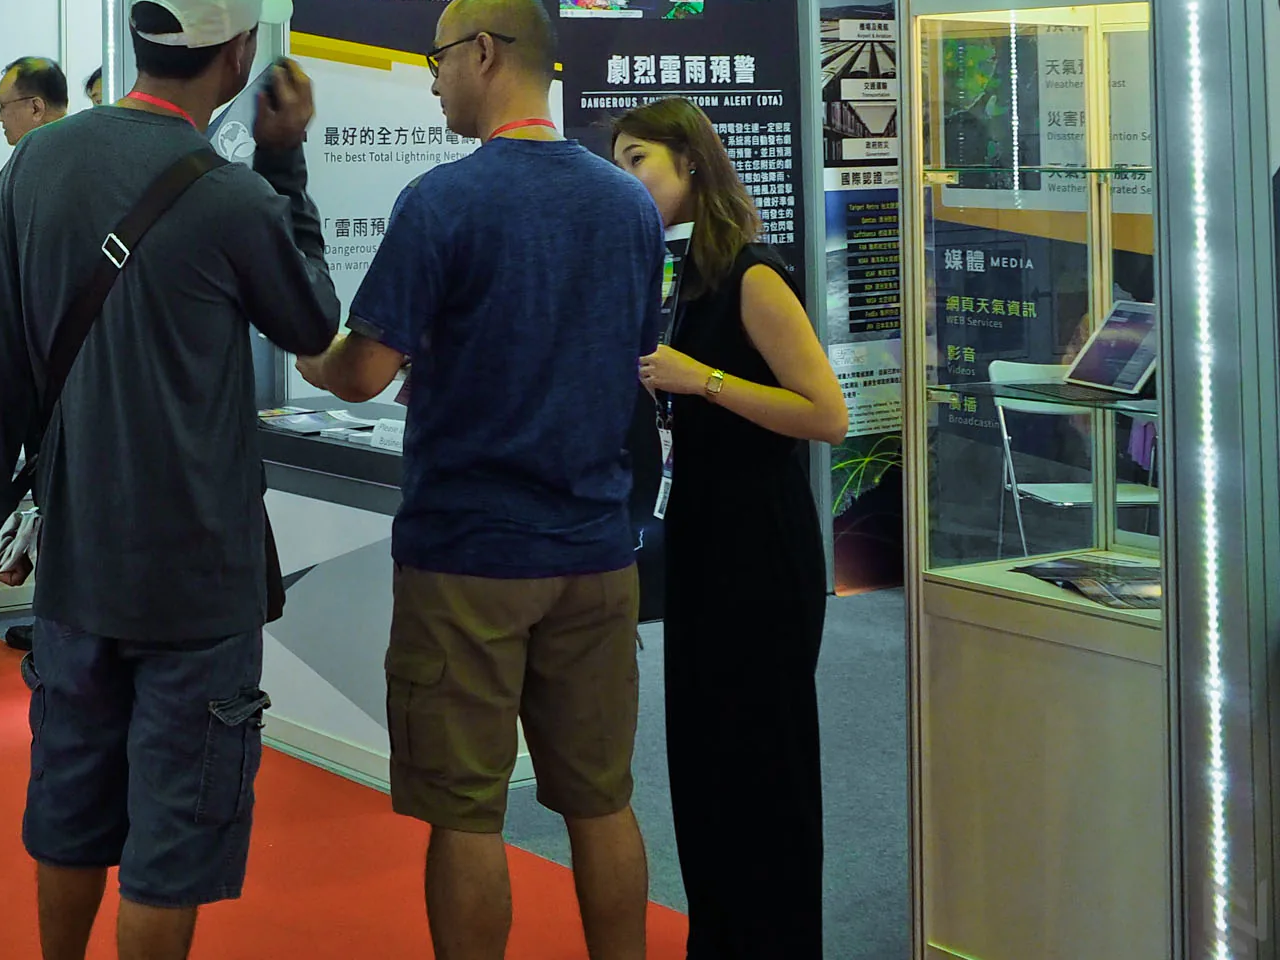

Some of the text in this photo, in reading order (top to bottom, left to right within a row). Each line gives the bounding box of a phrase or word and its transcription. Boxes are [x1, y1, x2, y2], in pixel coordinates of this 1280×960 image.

[607, 55, 755, 85] 劇烈雷雨預警
[1046, 59, 1084, 75] 天氣
[1046, 79, 1084, 88] Weather
[581, 97, 637, 108] DANGEROUS
[724, 96, 751, 106] ALERT
[756, 94, 783, 106] (DTA)
[1047, 132, 1084, 140] Disaster
[324, 152, 342, 162] The
[345, 152, 366, 162] best
[370, 152, 392, 162] Total
[396, 152, 440, 164] Lightning
[1047, 183, 1086, 192] Weather
[325, 244, 376, 256] Dangerous
[345, 261, 369, 271] warn
[944, 248, 1034, 272] 媒體 MEDIA
[945, 295, 1037, 318] 網頁天氣資訊
[967, 316, 1003, 328] Services
[947, 344, 976, 363] 影音
[947, 365, 976, 376] Videos
